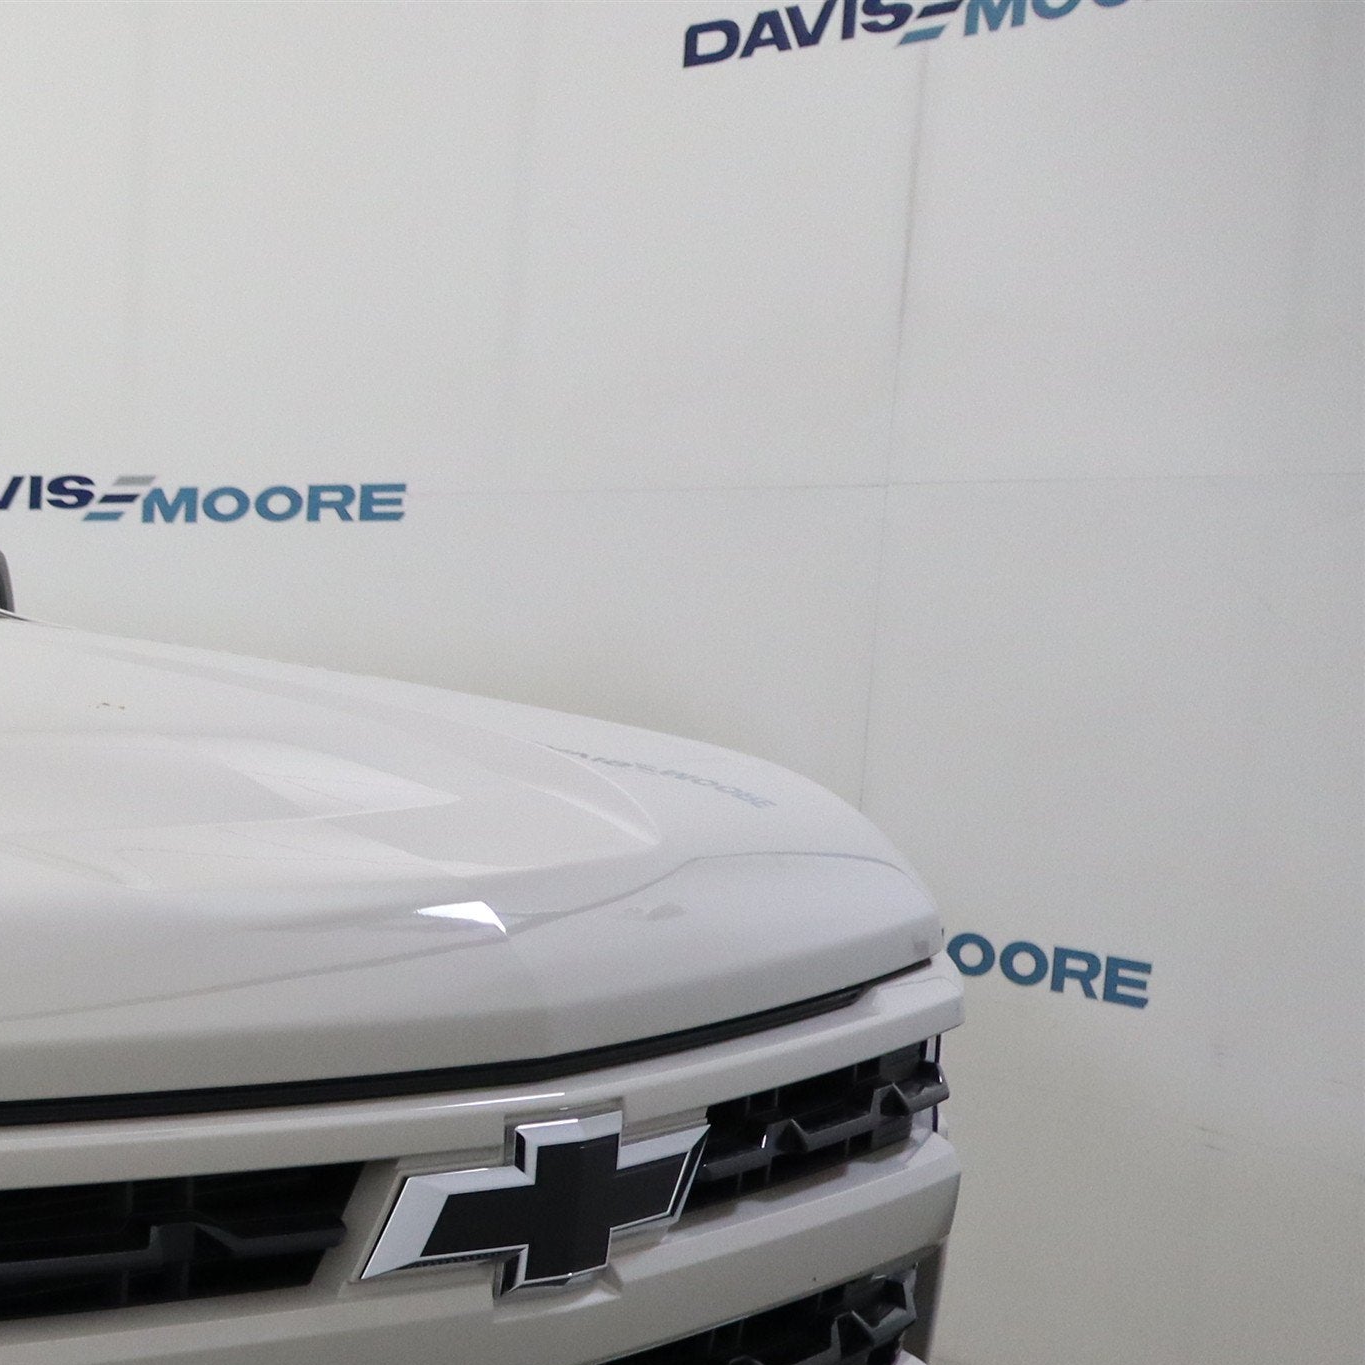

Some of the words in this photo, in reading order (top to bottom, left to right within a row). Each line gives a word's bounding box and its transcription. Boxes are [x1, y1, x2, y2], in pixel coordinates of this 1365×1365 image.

[682, 0, 914, 68] DAVIS
[141, 483, 408, 524] MOORE
[945, 931, 1153, 1010] OORE
